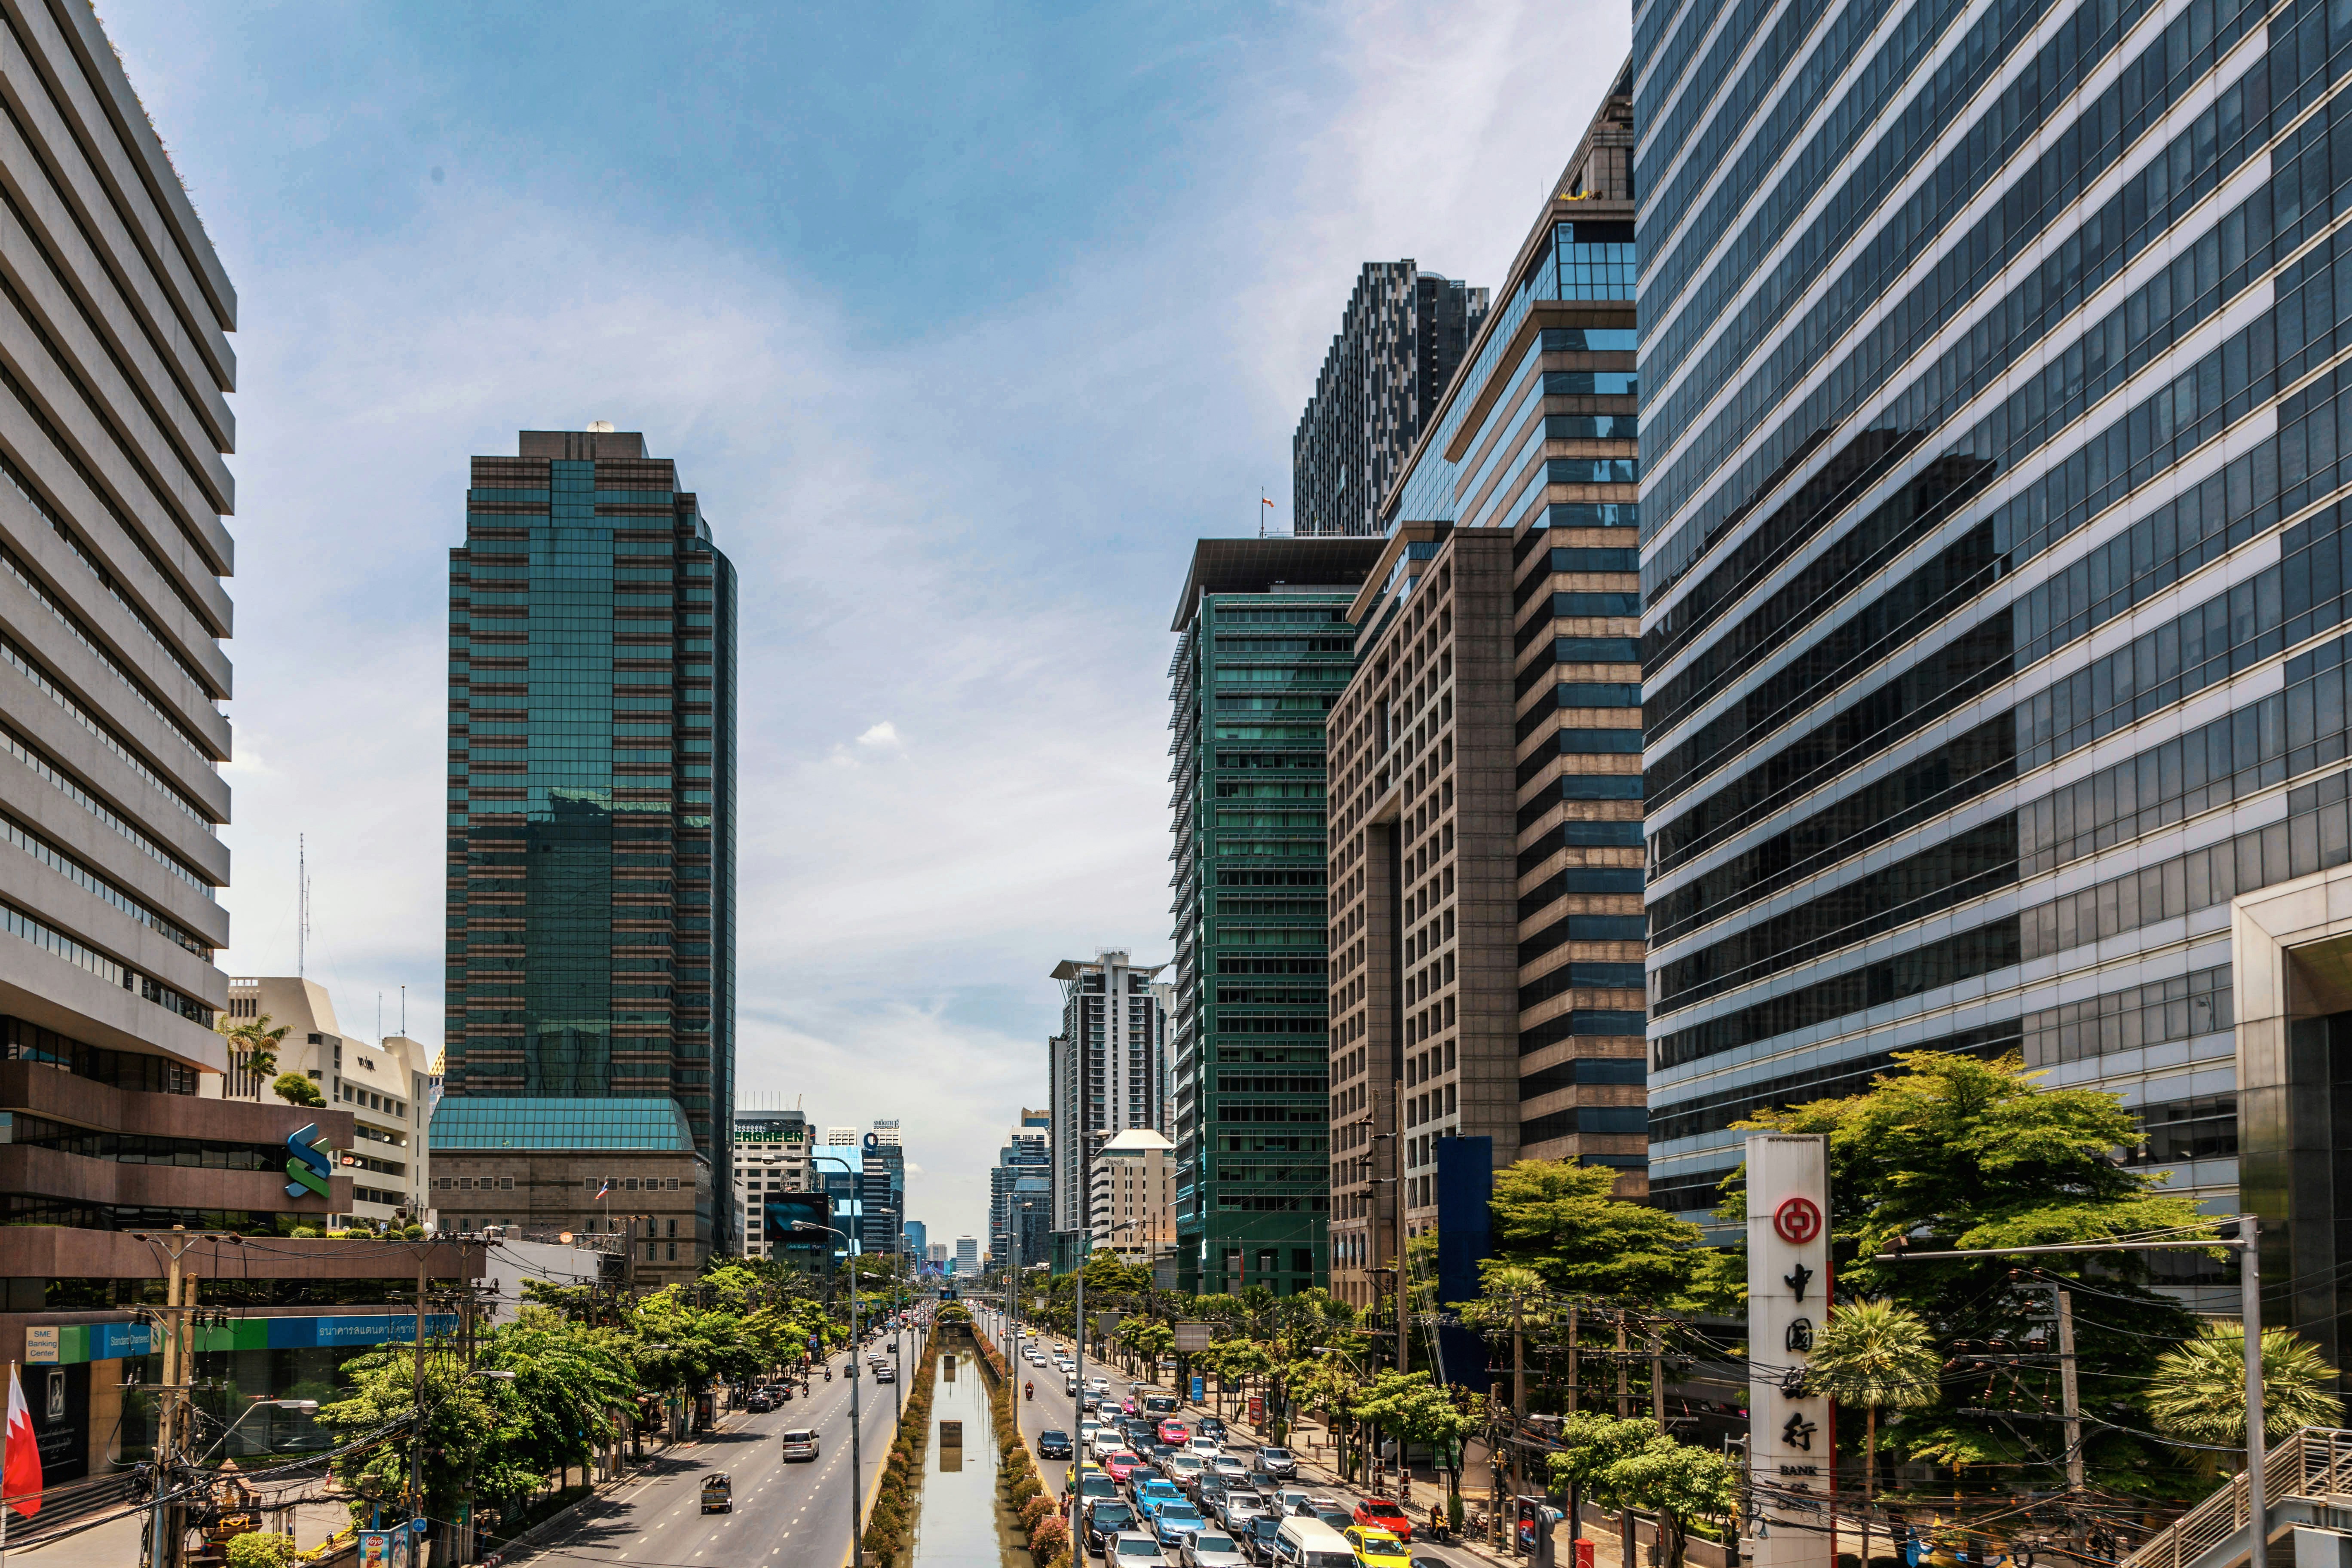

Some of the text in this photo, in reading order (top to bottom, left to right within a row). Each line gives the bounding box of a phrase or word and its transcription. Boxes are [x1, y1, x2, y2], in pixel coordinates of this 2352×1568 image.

[110, 1334, 149, 1346] Standard Chartered
[1780, 1465, 1818, 1476] BANK
[366, 1537, 382, 1546] Yoyo
